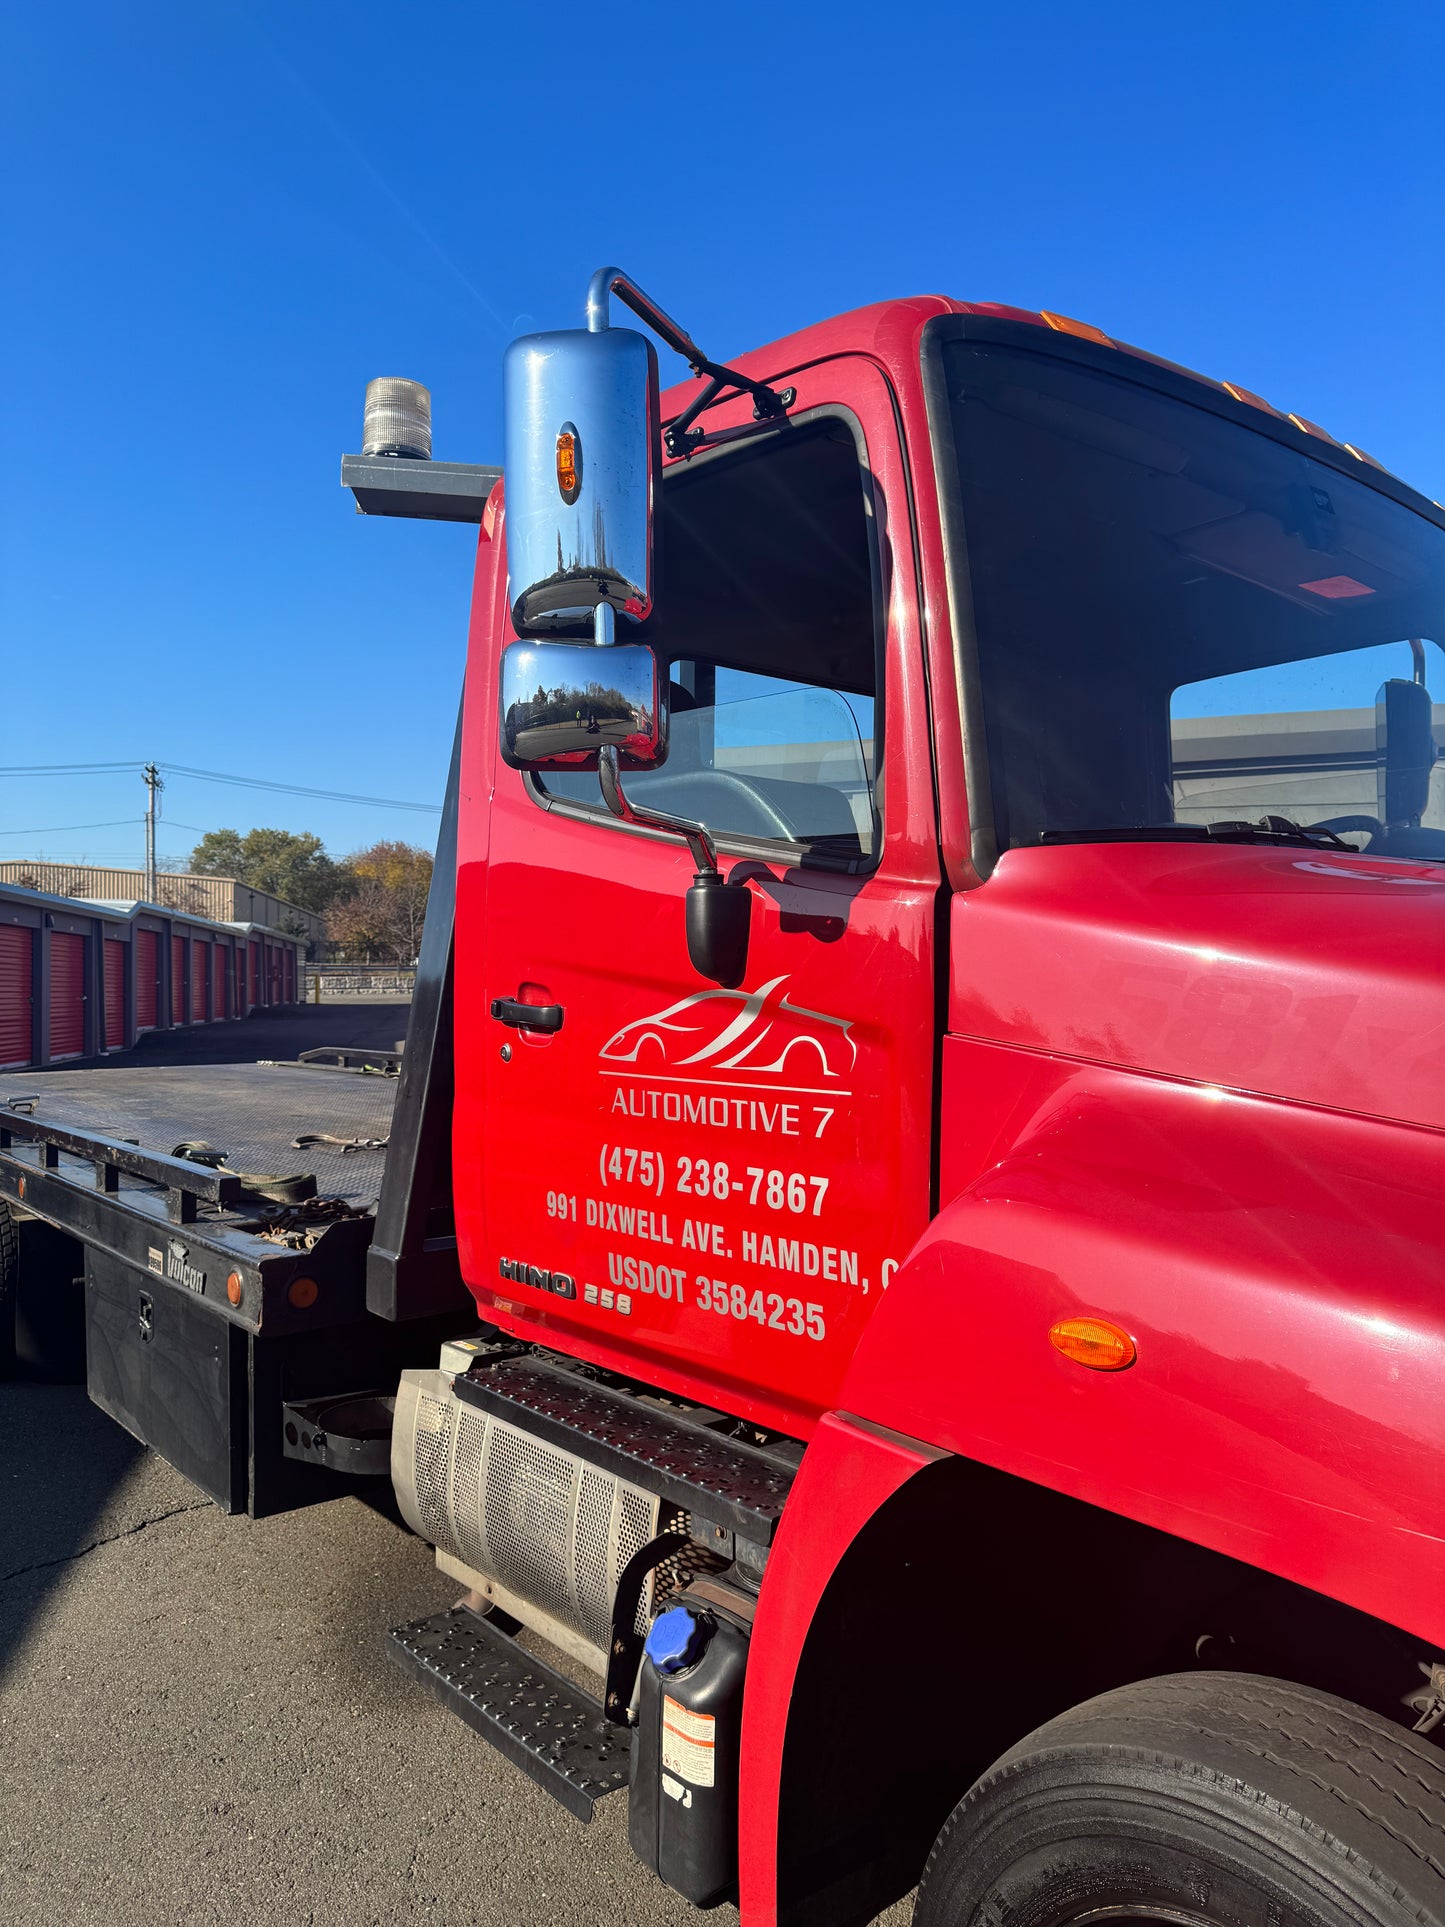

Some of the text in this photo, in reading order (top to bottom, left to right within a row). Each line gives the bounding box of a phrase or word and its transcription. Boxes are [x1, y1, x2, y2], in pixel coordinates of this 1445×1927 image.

[612, 1088, 834, 1137] AUTOMOTIVE 7
[600, 1144, 828, 1216] (475) 238-7867
[547, 1191, 576, 1221] 991
[587, 1199, 673, 1244] DIXWELL
[682, 1219, 732, 1257] AVE.
[743, 1231, 868, 1294] HAMDEN,
[500, 1257, 632, 1316] HINO 258
[609, 1253, 825, 1340] USDOT 3584235
